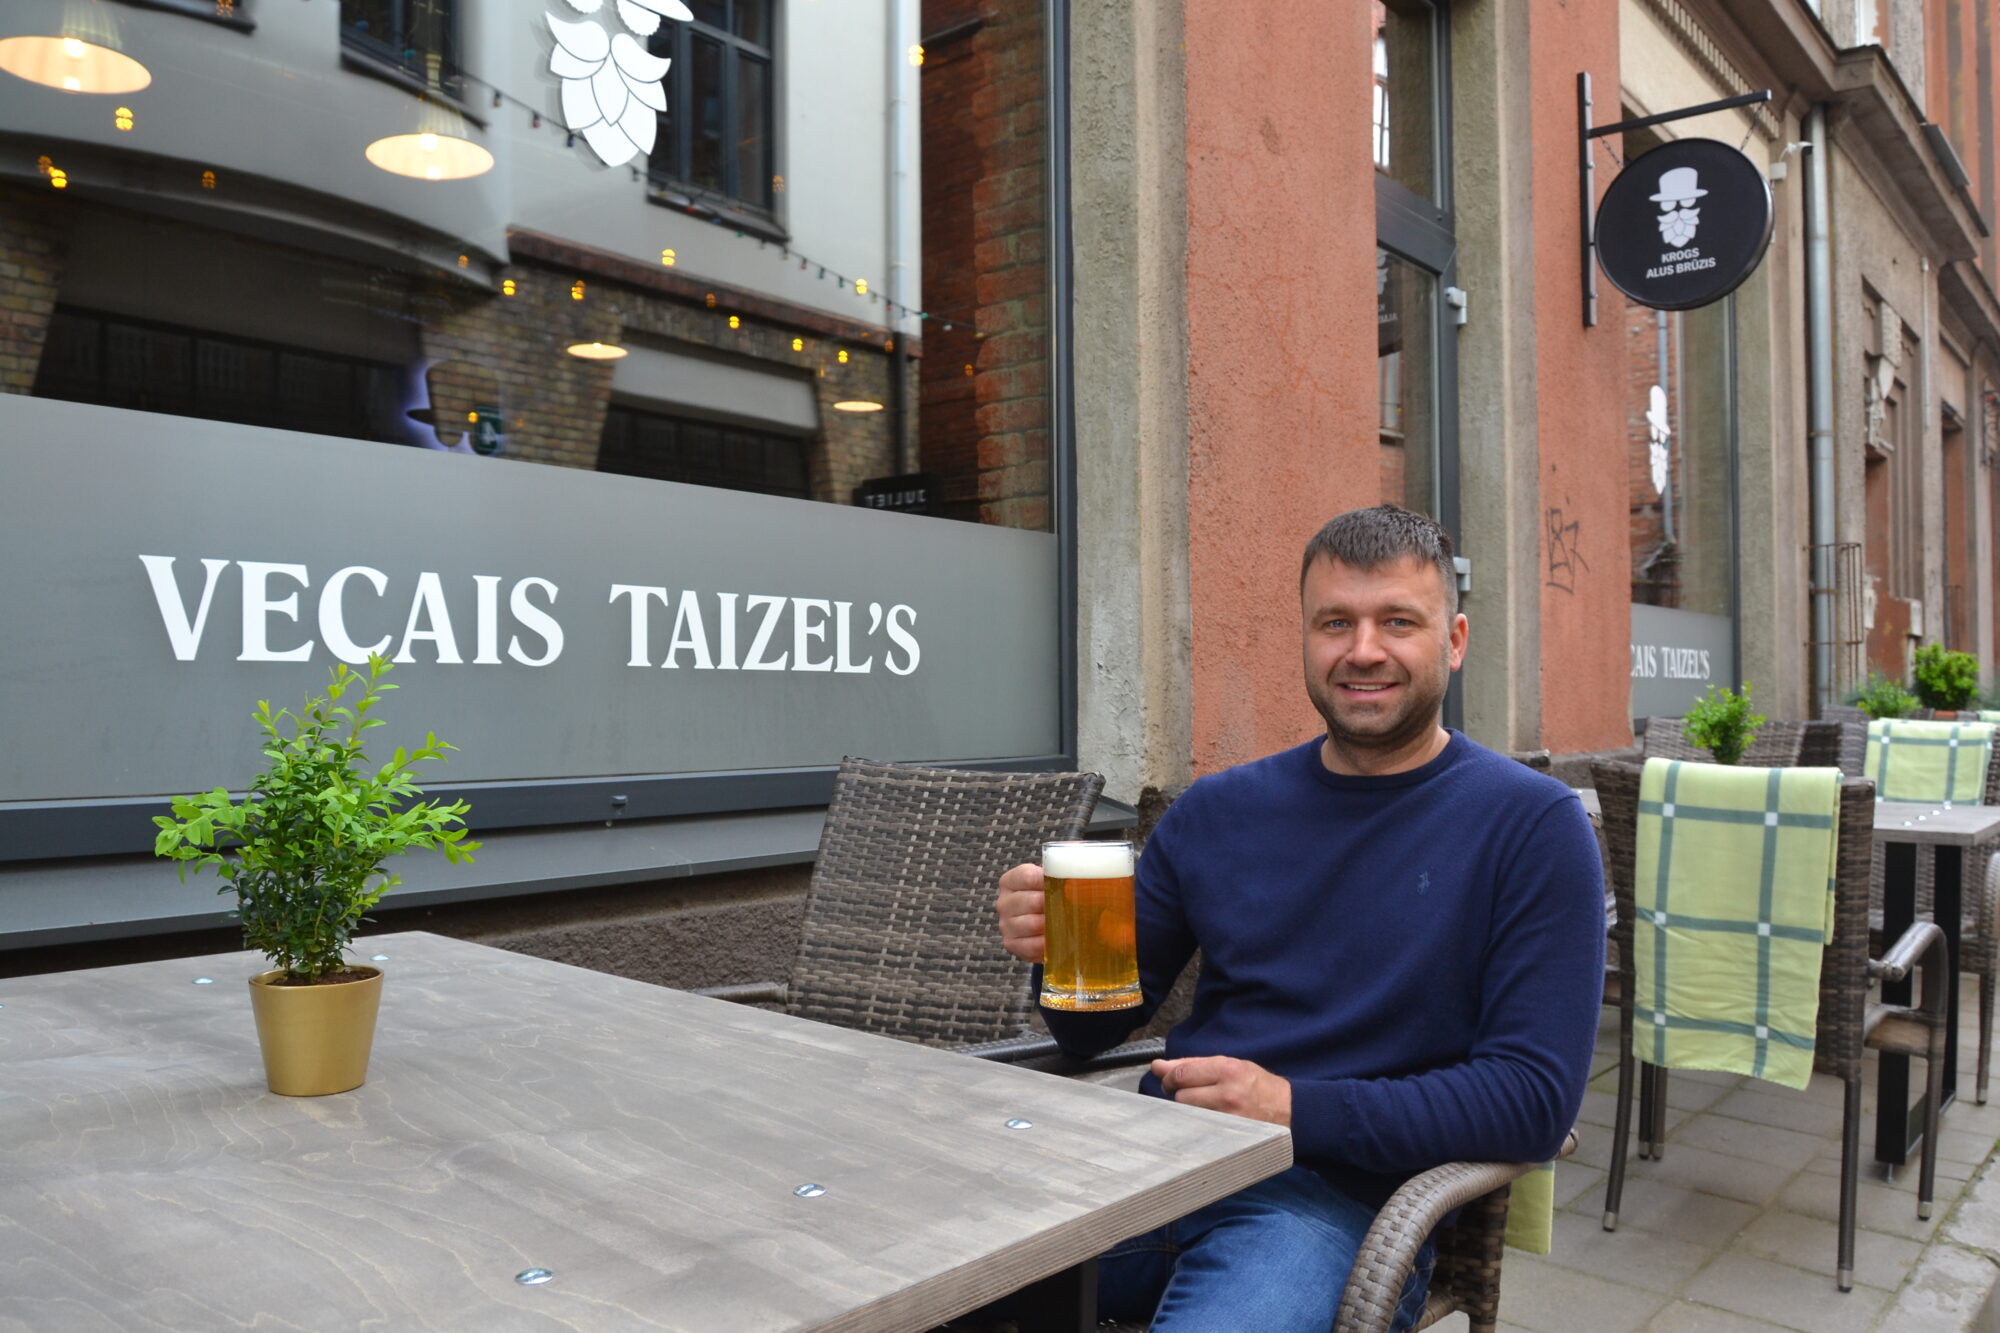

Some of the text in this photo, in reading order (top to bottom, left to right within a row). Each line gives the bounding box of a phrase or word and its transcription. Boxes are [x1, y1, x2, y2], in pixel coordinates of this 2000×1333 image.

[1661, 247, 1700, 263] KROGS
[1646, 264, 1675, 279] ALUS
[139, 554, 565, 667] VECAIS
